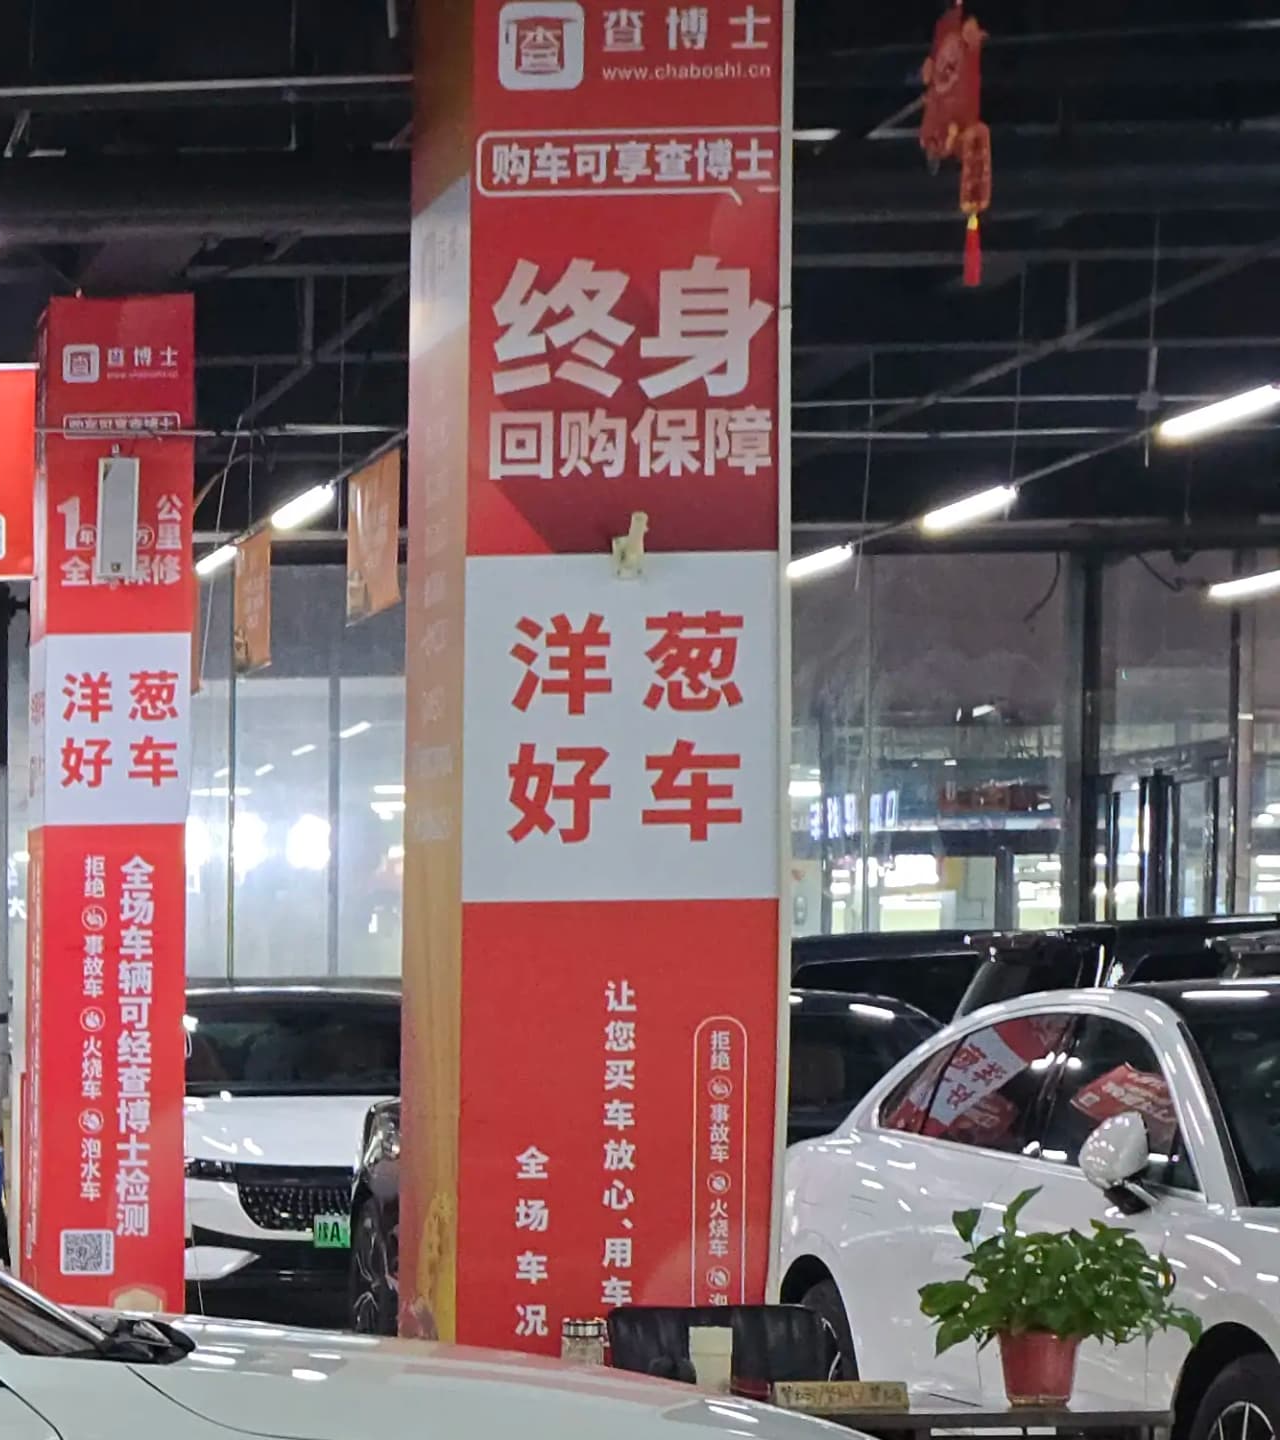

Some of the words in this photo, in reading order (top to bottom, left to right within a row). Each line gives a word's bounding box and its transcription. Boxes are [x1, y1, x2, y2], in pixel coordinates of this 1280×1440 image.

[602, 6, 771, 52] 查博士
[602, 62, 771, 81] www.chaboshi.cn
[493, 138, 774, 185] 购车可享查博士
[107, 346, 178, 367] 查博士
[492, 255, 775, 400] 终身
[488, 405, 773, 480] 回购保障
[60, 554, 182, 586] 全保修
[509, 610, 744, 716] 洋葱
[61, 670, 179, 723] 洋葱
[60, 735, 179, 790] 好车
[506, 739, 743, 844] 好车
[82, 935, 105, 999] 事故车
[81, 1037, 103, 1100] 火烧车
[116, 855, 156, 1238] 全场车辆可经查博士检测
[710, 1030, 731, 1071] 拒绝
[601, 980, 637, 1307] 让您买车放心、用车
[709, 1103, 731, 1163] 事故车
[515, 1145, 550, 1337] 全场车况
[708, 1200, 730, 1258] 火烧车
